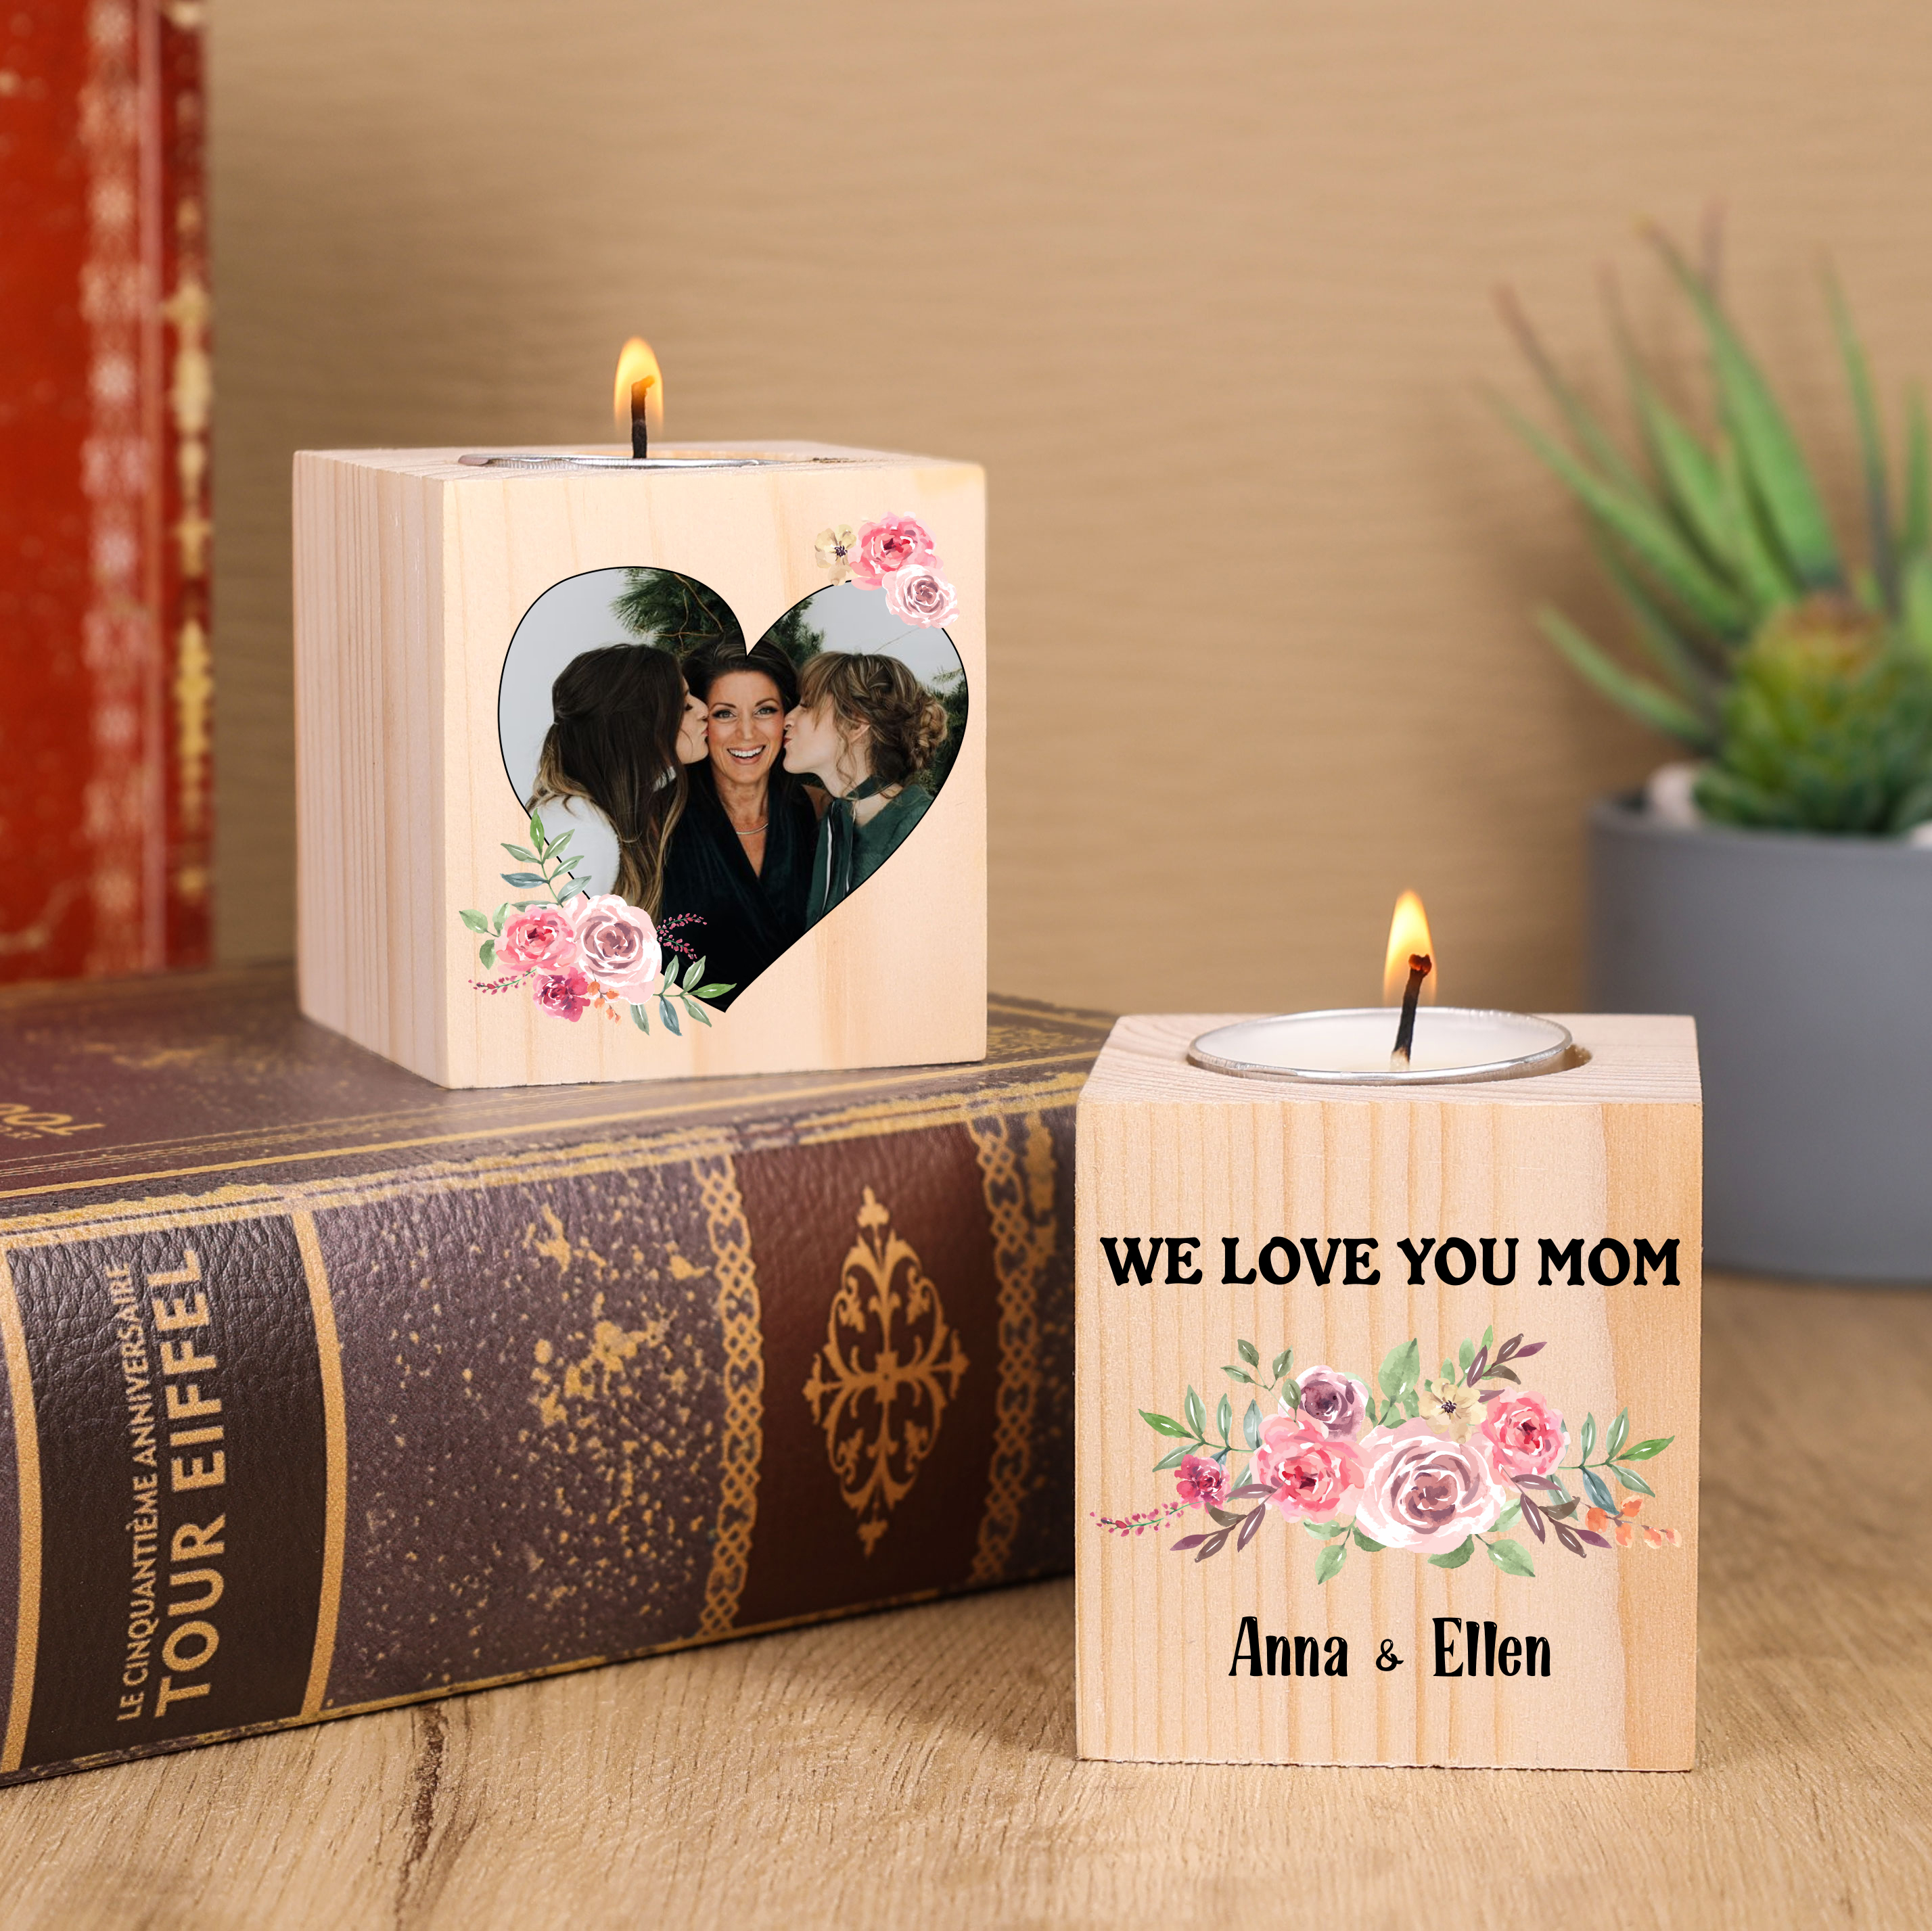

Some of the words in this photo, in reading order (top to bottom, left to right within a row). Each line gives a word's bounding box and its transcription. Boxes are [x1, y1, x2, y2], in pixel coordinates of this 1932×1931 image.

[1100, 1237, 1203, 1286] WE
[1221, 1236, 1381, 1287] LOVE
[1396, 1237, 1519, 1286] YOU
[1538, 1238, 1680, 1286] MOM
[106, 1262, 157, 1468] ANNIVERSAIRE
[146, 1249, 226, 1492] EIFFEL
[122, 1473, 159, 1687] CINQUANTIÈME
[154, 1512, 227, 1718] TOUR
[1228, 1616, 1348, 1677] Anna
[1375, 1638, 1404, 1672] &
[1432, 1617, 1551, 1677] Ellen
[116, 1692, 145, 1721] LE
